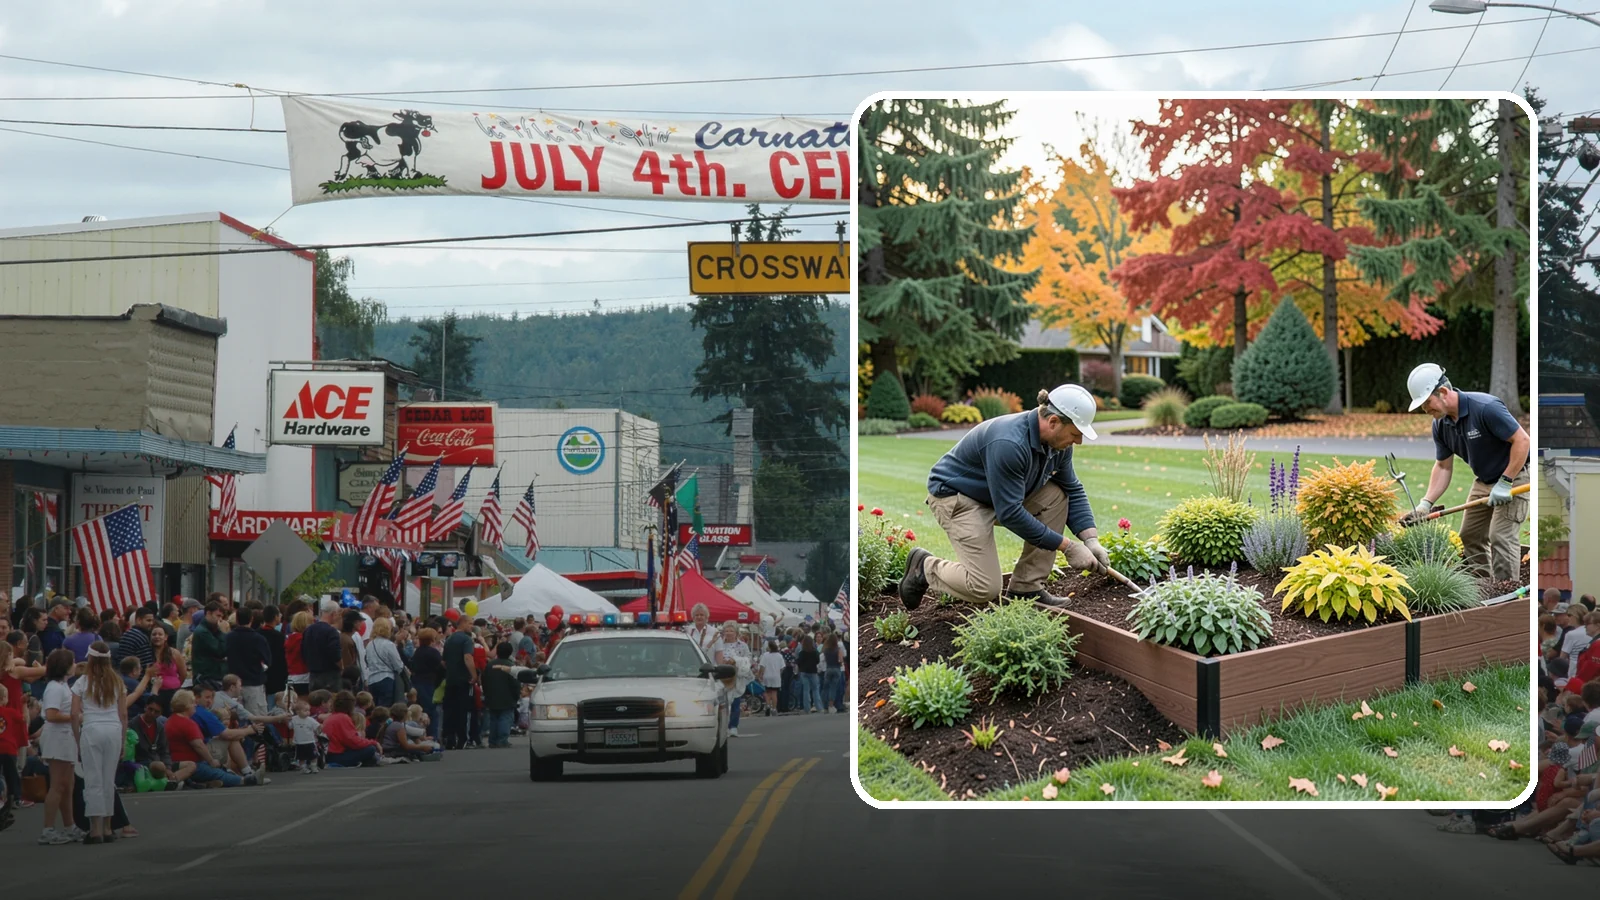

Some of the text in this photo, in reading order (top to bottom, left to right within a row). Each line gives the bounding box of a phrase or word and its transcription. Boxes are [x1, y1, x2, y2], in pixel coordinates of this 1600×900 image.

[481, 141, 605, 192] JULY
[632, 150, 746, 198] 4th.
[697, 254, 850, 280] CROSSWA
[283, 380, 374, 420] ACE
[405, 409, 485, 422] CEDAR LOG
[283, 421, 371, 437] Hardware
[416, 428, 477, 447] Coca-Cola
[353, 467, 386, 480] Simpl
[83, 485, 155, 495] St. Vincent de Paul
[212, 516, 331, 535] HARDARE
[688, 526, 741, 535] CRNATION
[699, 535, 730, 543] GLASS
